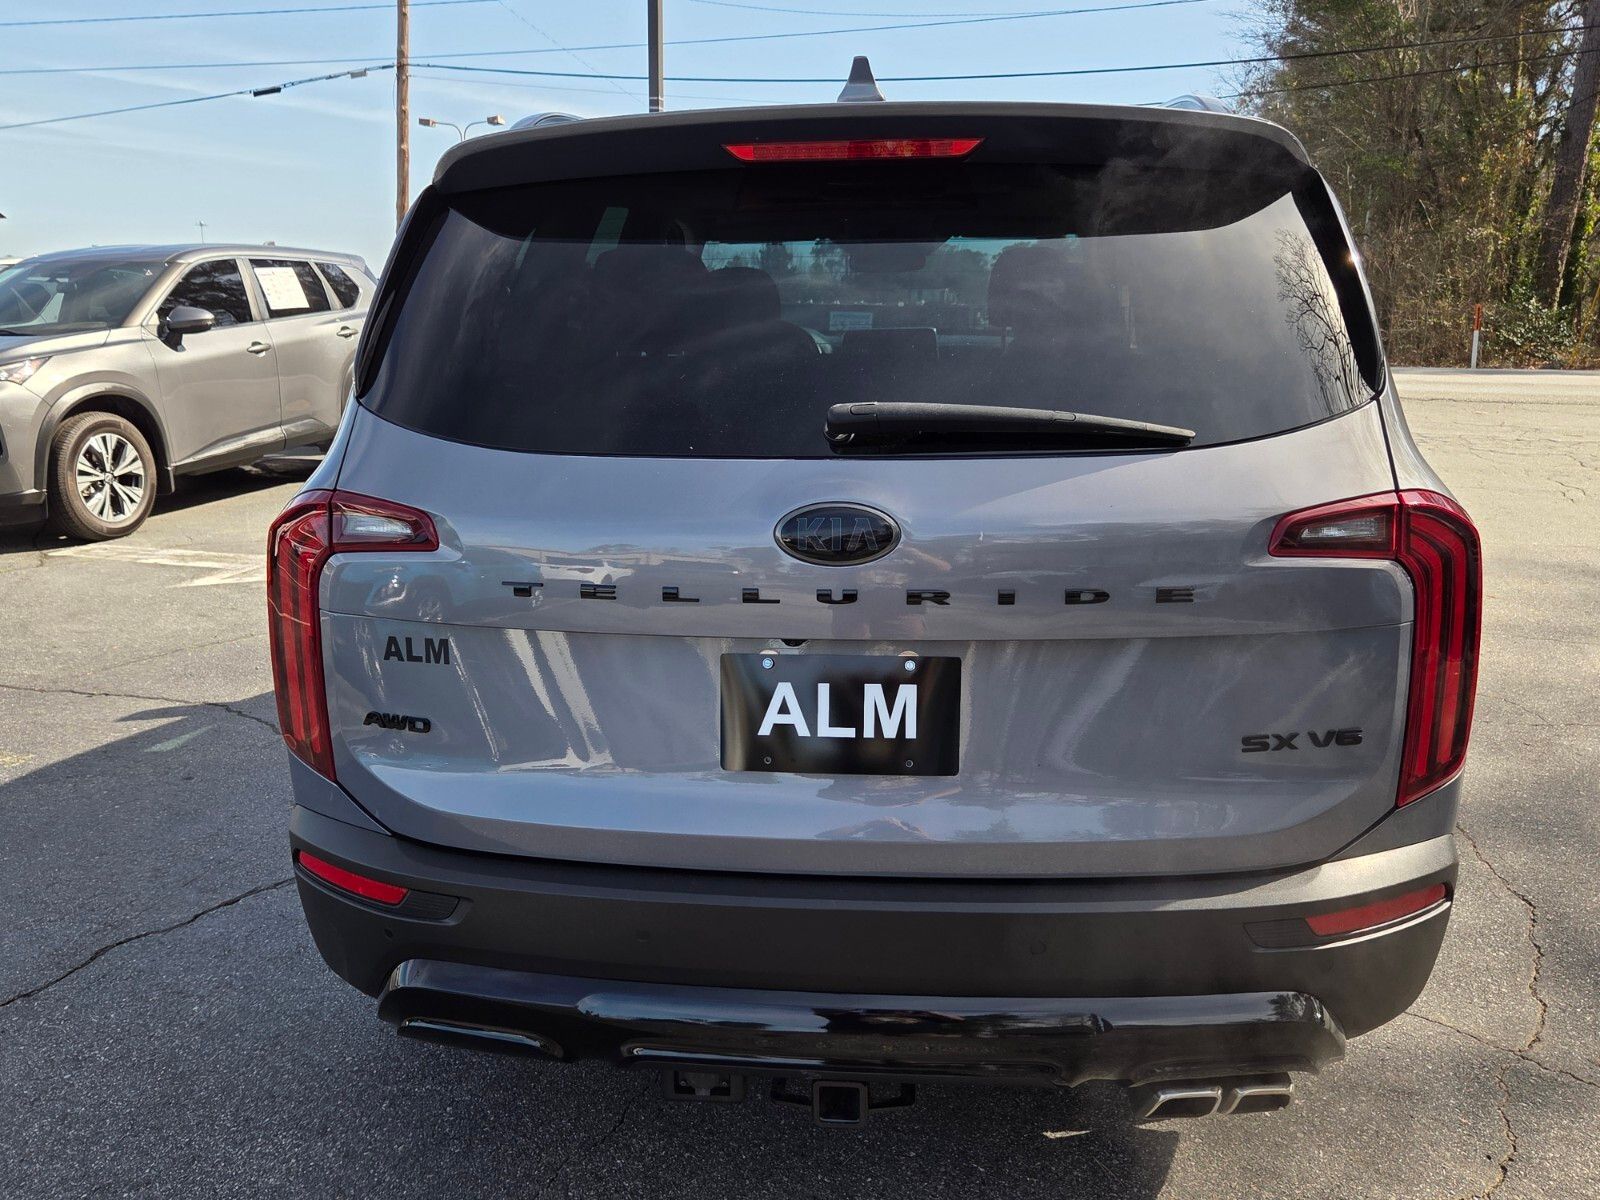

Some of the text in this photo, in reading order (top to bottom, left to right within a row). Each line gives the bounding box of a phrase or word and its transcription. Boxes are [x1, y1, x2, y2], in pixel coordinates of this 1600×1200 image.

[797, 517, 879, 551] KIA
[502, 581, 1194, 606] TELLURIDE
[383, 635, 450, 665] ALM
[363, 710, 431, 733] AWD
[757, 682, 918, 739] ALM
[1241, 727, 1363, 753] SX V6
